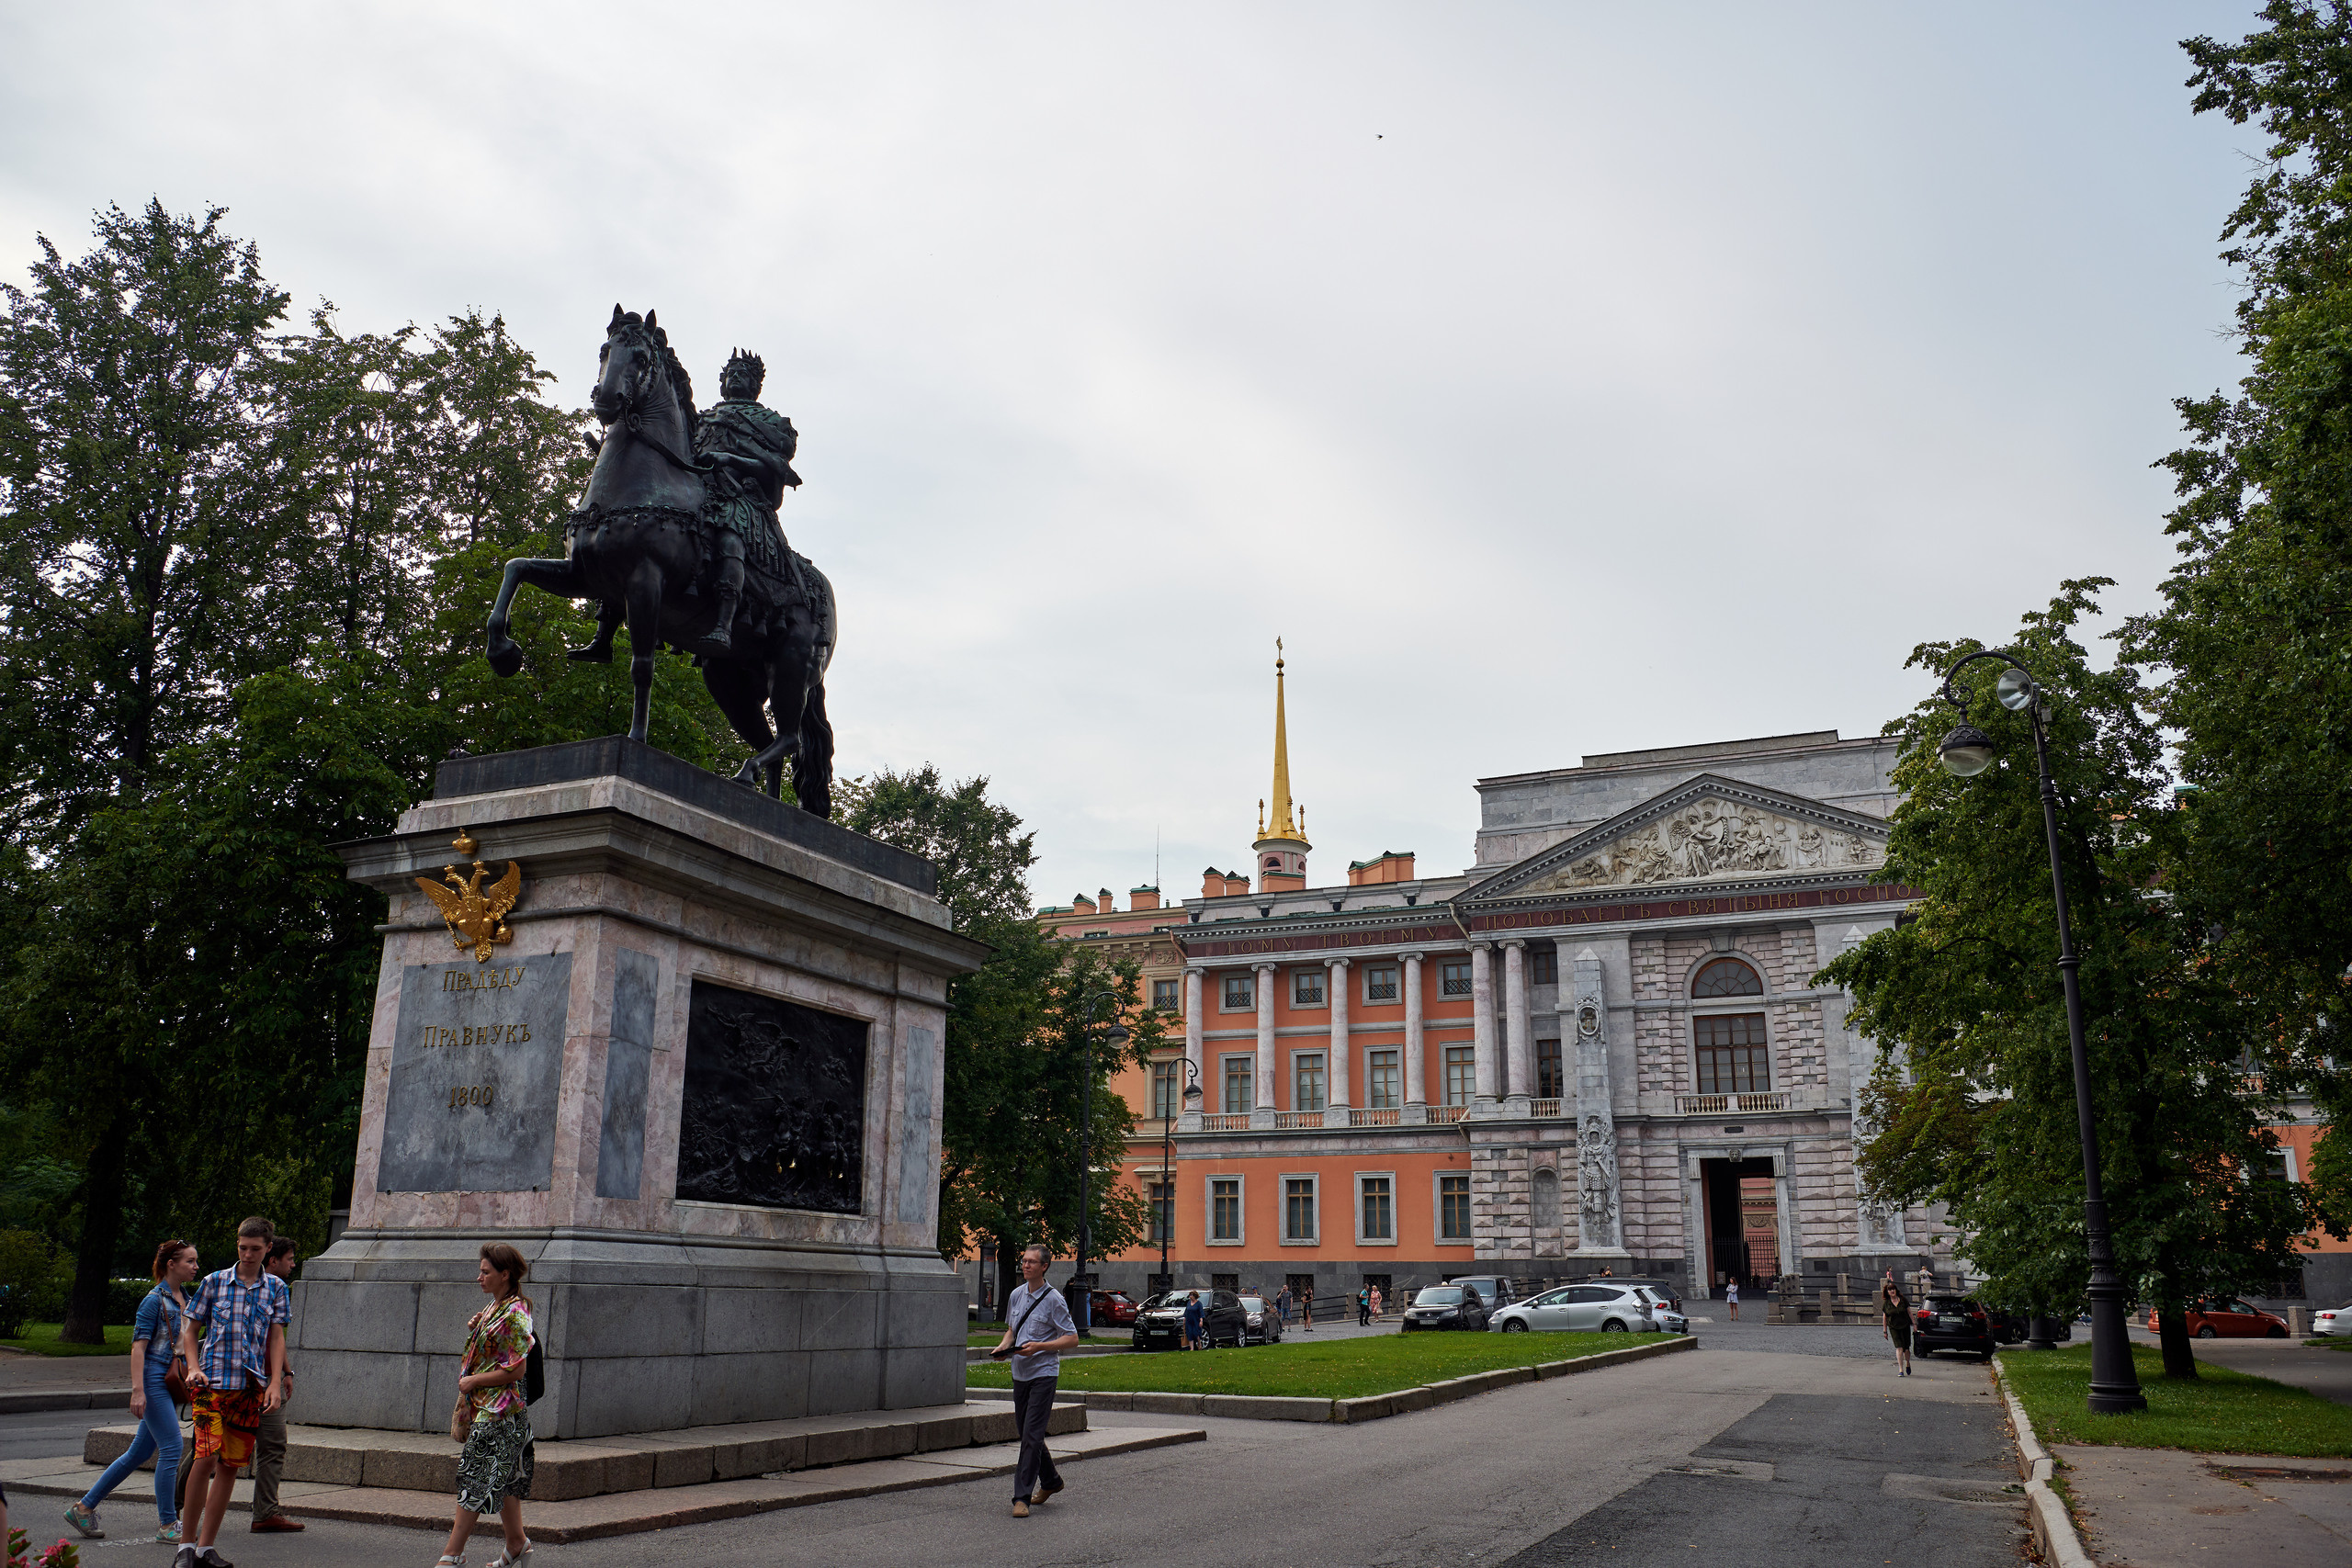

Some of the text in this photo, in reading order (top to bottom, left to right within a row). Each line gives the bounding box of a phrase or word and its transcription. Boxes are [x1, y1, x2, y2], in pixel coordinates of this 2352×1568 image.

[1224, 938, 1295, 955] ДОМУ
[1319, 927, 1439, 948] ТВОЕМУ
[1486, 904, 1651, 930] ПОДОБАЕТЪ
[423, 1022, 532, 1048] ПРАВНУКЪ
[447, 1086, 493, 1109] 1800
